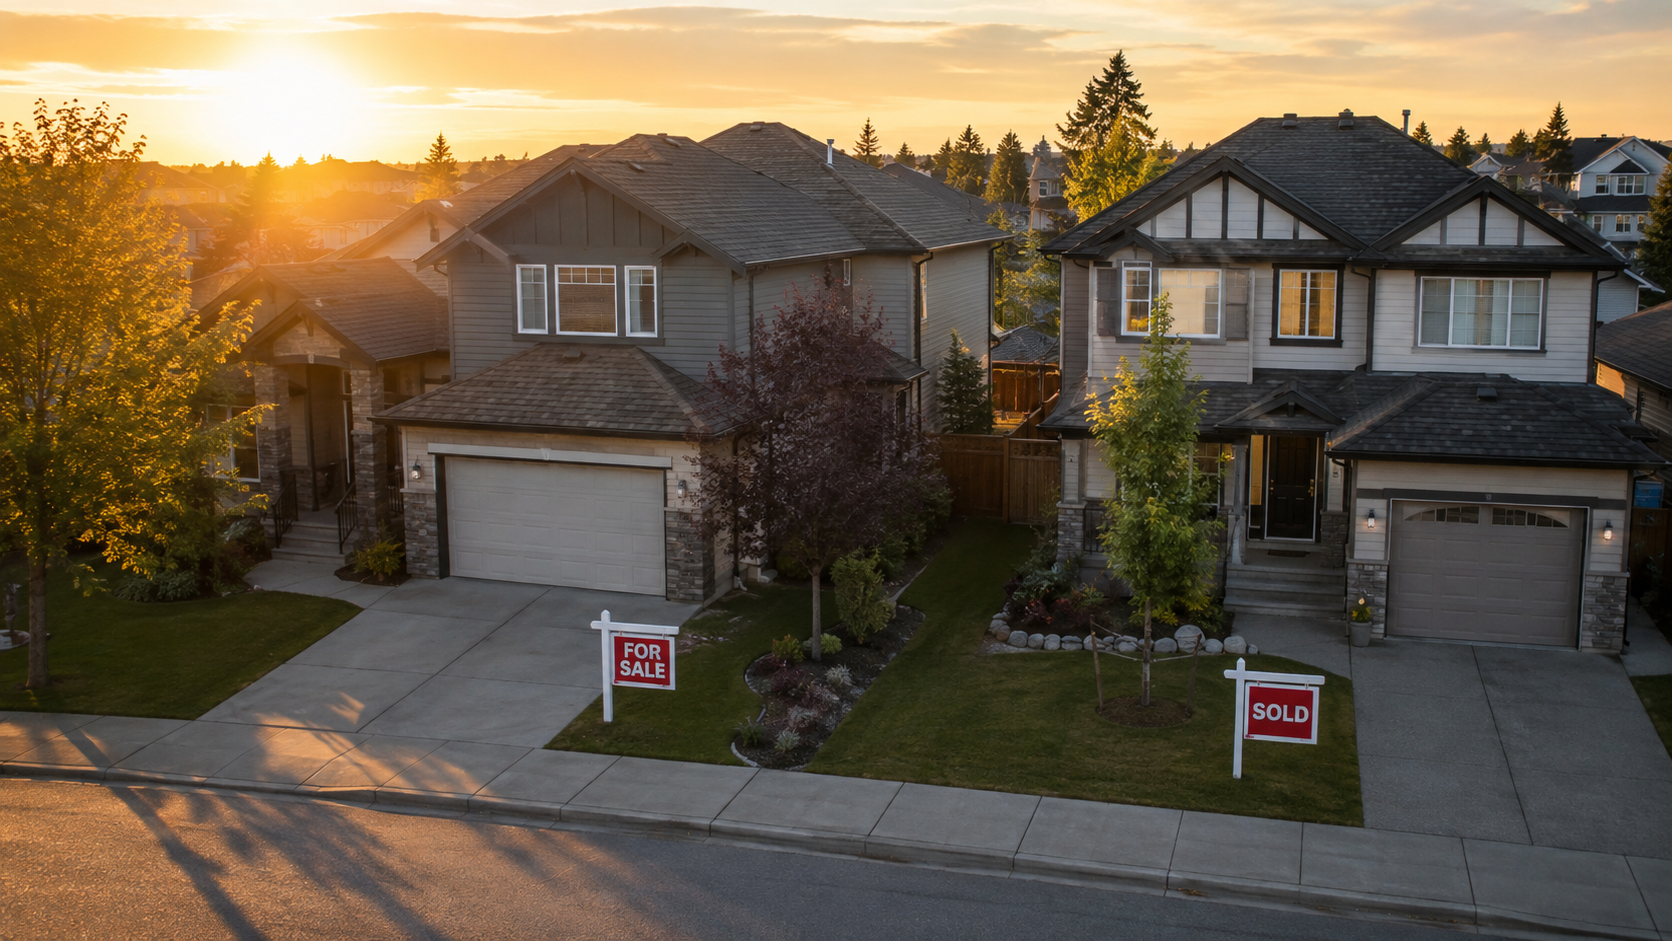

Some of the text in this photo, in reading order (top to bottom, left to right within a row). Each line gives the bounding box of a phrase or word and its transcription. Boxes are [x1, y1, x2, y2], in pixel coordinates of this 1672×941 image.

[624, 642, 661, 660] FOR
[620, 660, 665, 679] SALE
[1252, 702, 1309, 723] SOLD
